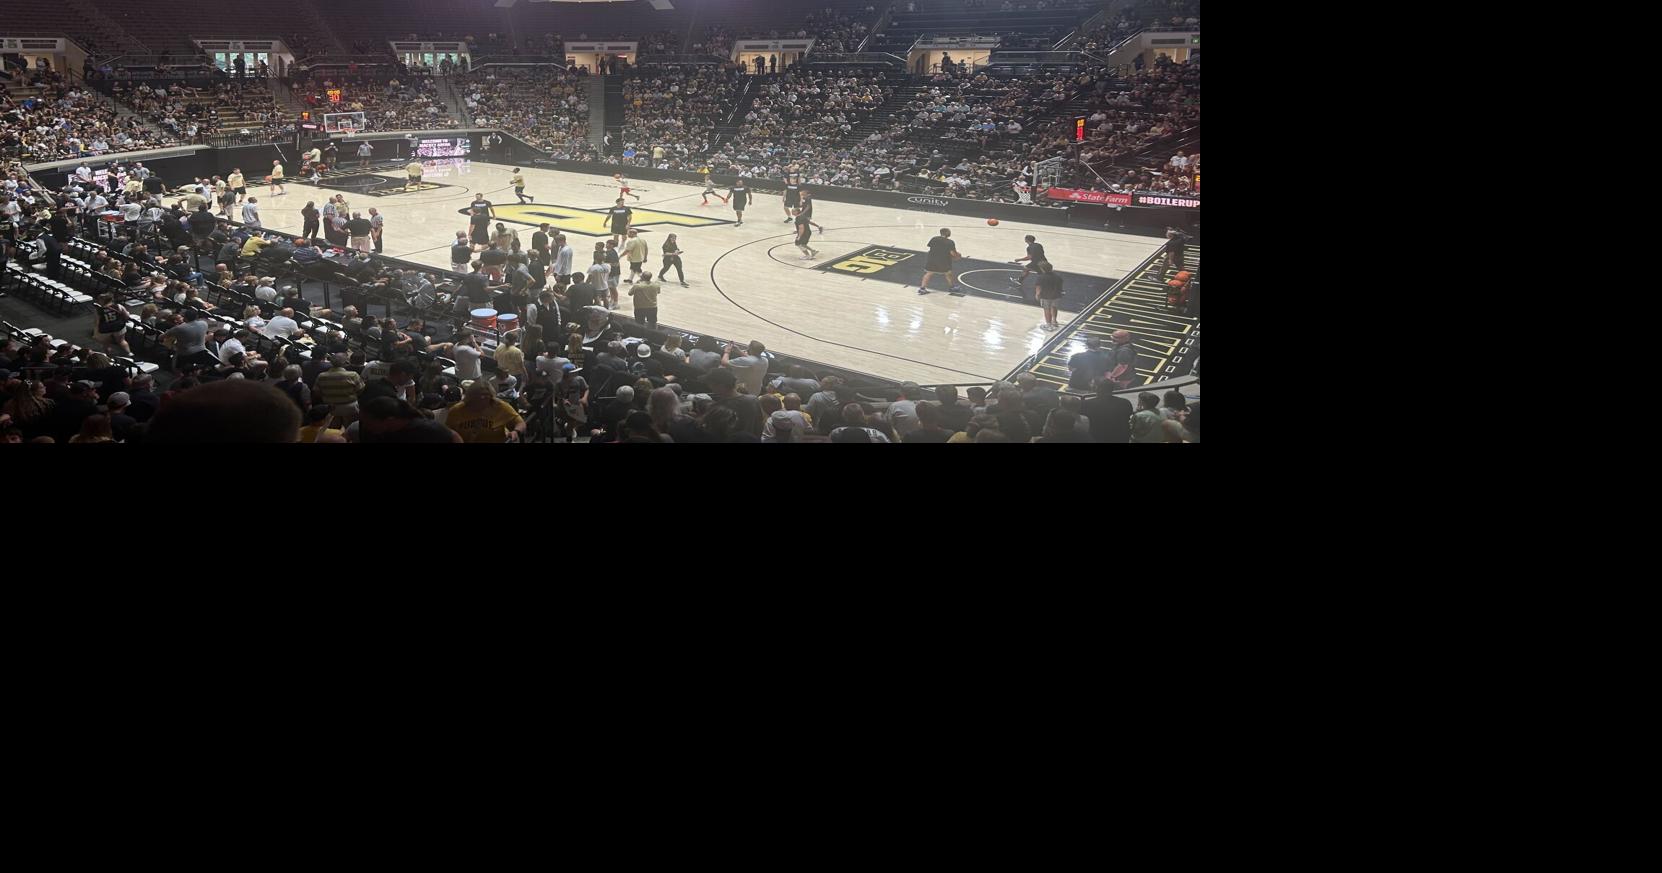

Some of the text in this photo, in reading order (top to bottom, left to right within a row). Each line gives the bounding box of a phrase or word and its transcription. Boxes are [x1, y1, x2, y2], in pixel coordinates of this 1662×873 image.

[1082, 193, 1128, 204] State Farm
[1138, 196, 1200, 208] #BOILERUP
